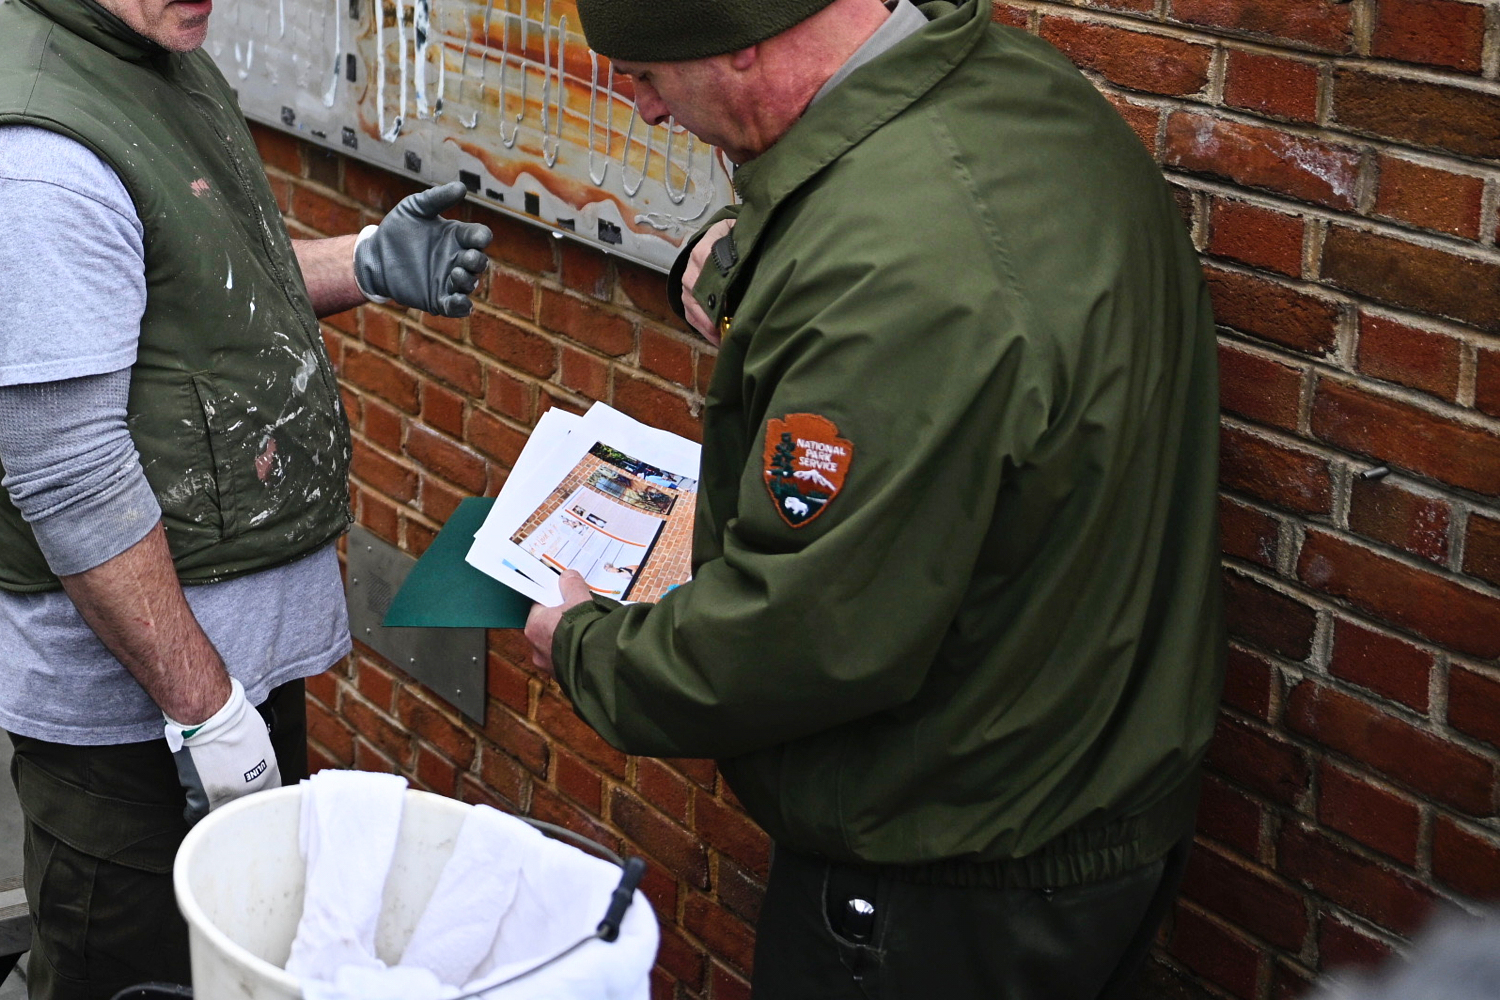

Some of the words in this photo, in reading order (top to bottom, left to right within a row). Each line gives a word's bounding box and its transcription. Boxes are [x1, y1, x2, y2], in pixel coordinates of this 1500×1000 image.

[796, 438, 846, 456] NATIONAL
[805, 448, 832, 463] PARK
[798, 456, 838, 473] SERVICE
[245, 761, 266, 781] ULINE
